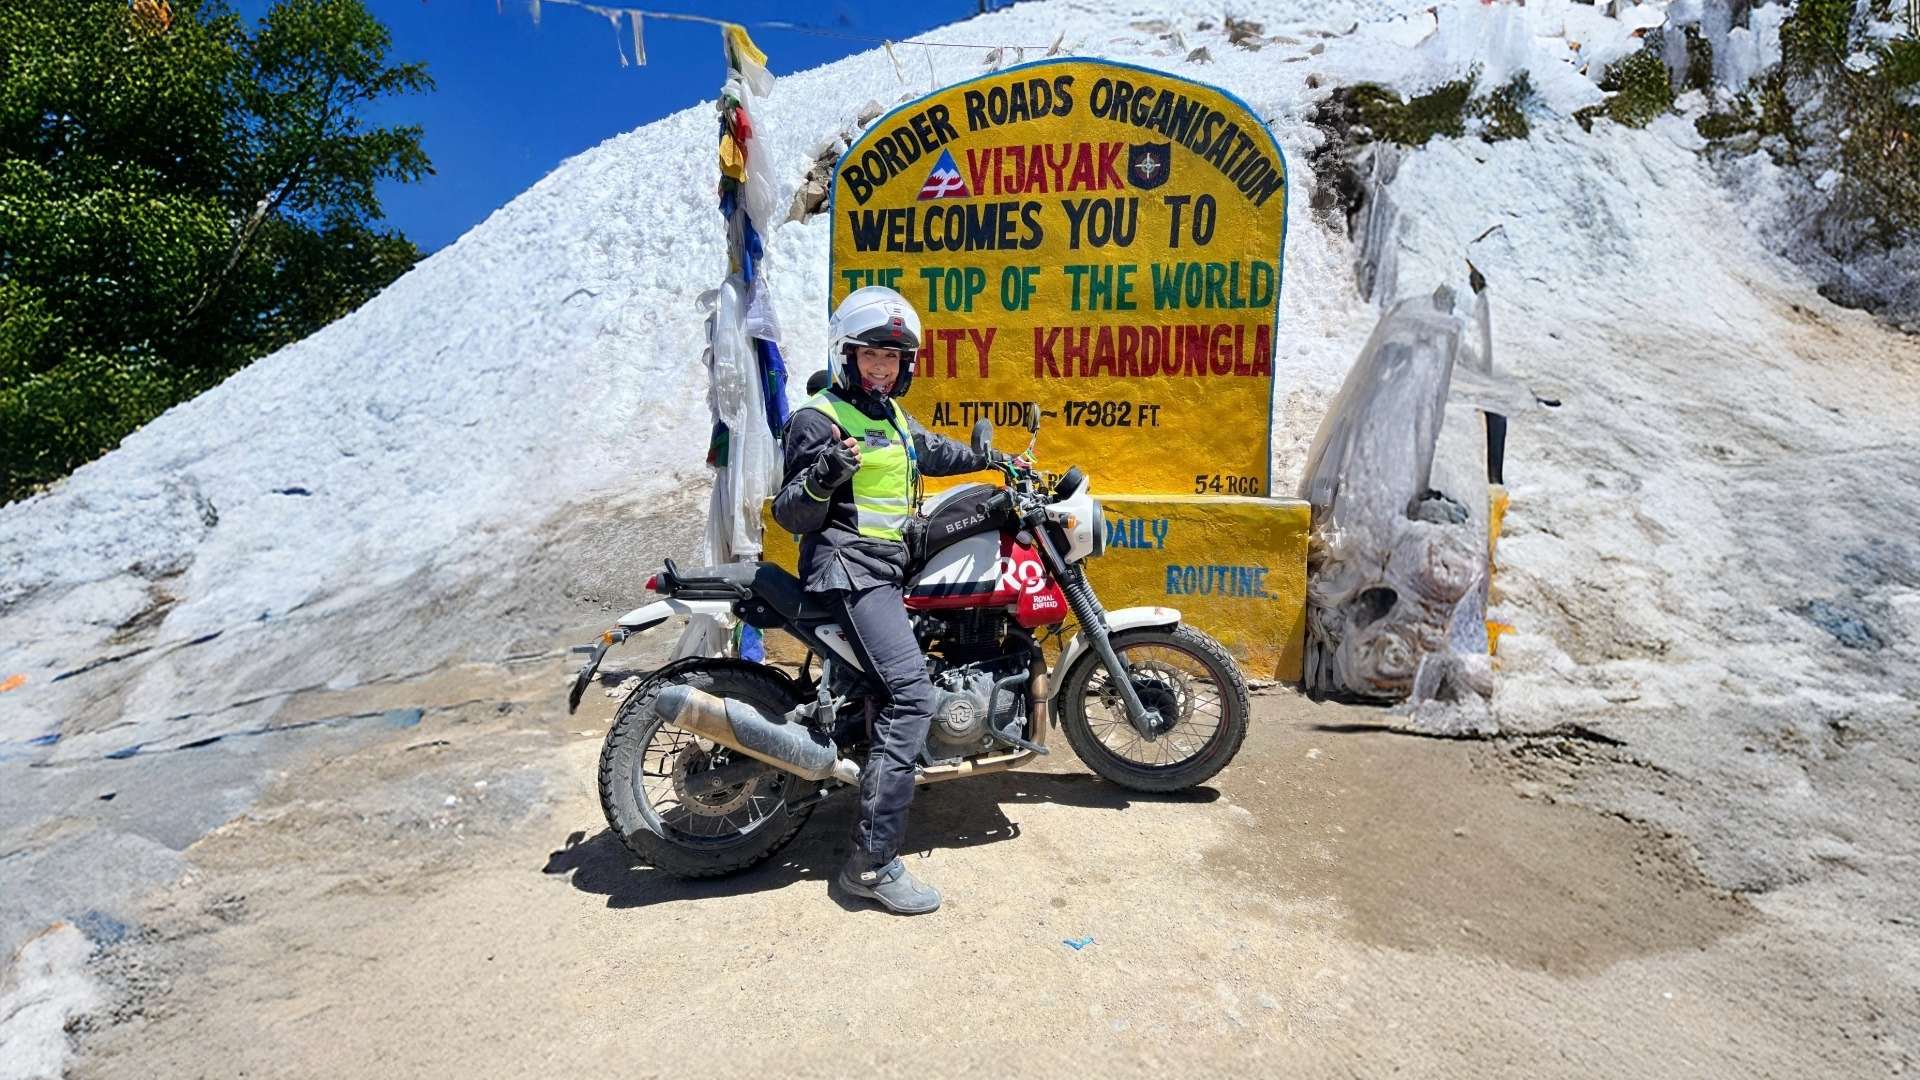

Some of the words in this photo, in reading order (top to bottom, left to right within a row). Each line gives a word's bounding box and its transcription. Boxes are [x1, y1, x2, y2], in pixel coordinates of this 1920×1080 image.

[841, 104, 960, 206] BORDER
[964, 75, 1073, 131] ROADS
[1090, 78, 1285, 208] ORGANISATION
[967, 141, 1125, 196] VIJAYAK
[848, 200, 1044, 252] WELCOMES
[1061, 197, 1139, 250] YOU
[1164, 193, 1217, 248] TO
[919, 266, 986, 312] TOP
[1002, 265, 1040, 311] OF
[1064, 264, 1138, 311] THE
[1151, 261, 1275, 310] WORLD
[1034, 324, 1273, 379] KHARDUNGLA
[1064, 400, 1132, 427] 17982
[1194, 474, 1223, 494] 54
